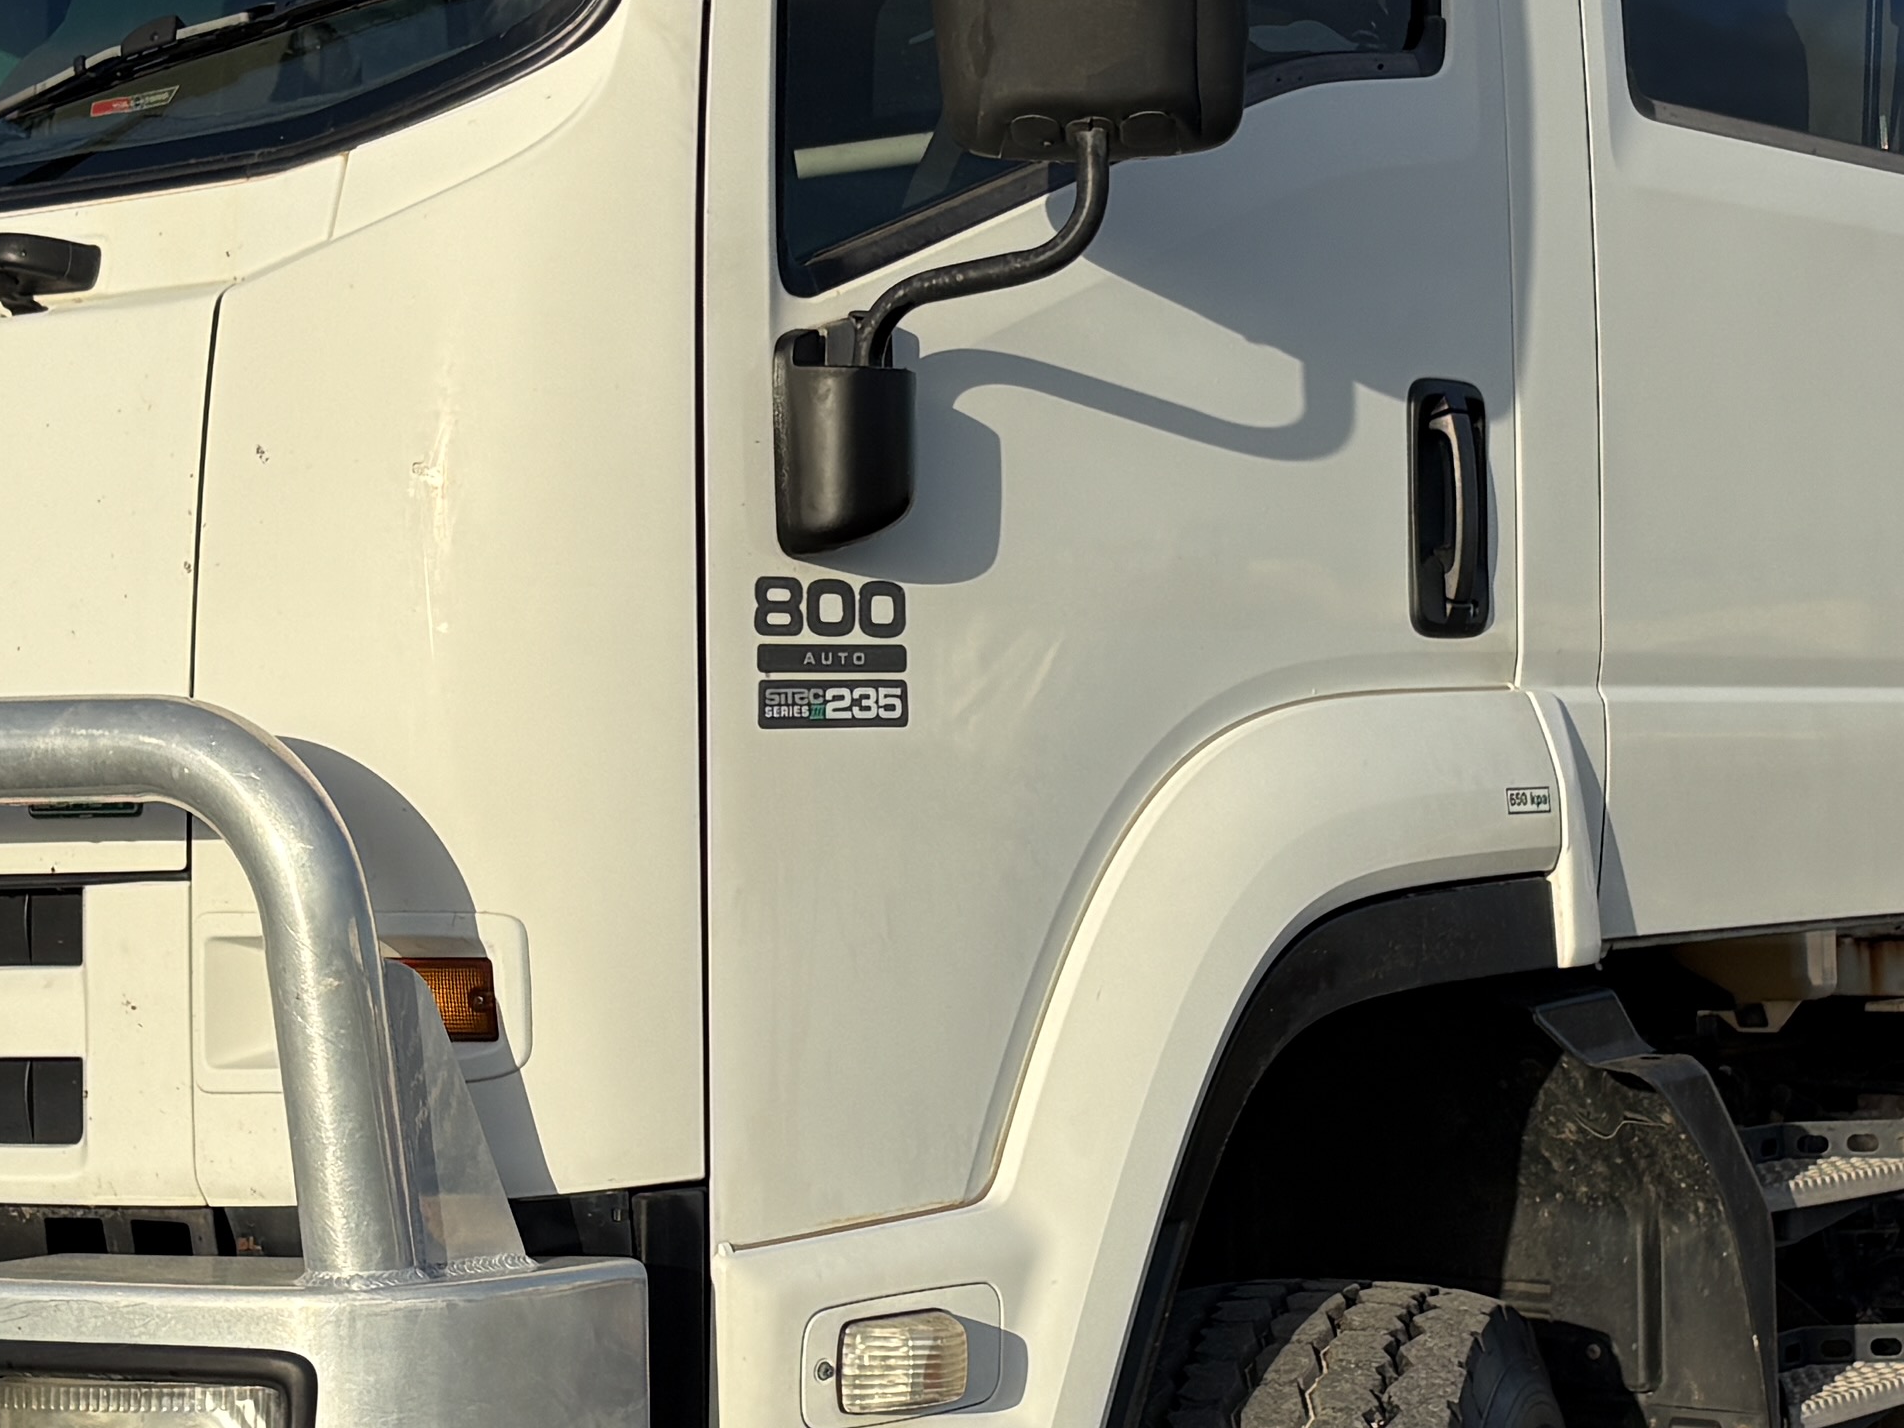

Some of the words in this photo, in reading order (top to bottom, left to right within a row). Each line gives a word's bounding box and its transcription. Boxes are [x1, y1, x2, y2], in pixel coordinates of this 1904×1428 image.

[754, 576, 906, 639] 800
[803, 651, 866, 666] AUTO
[765, 705, 809, 719] SERIES
[825, 687, 903, 720] 235
